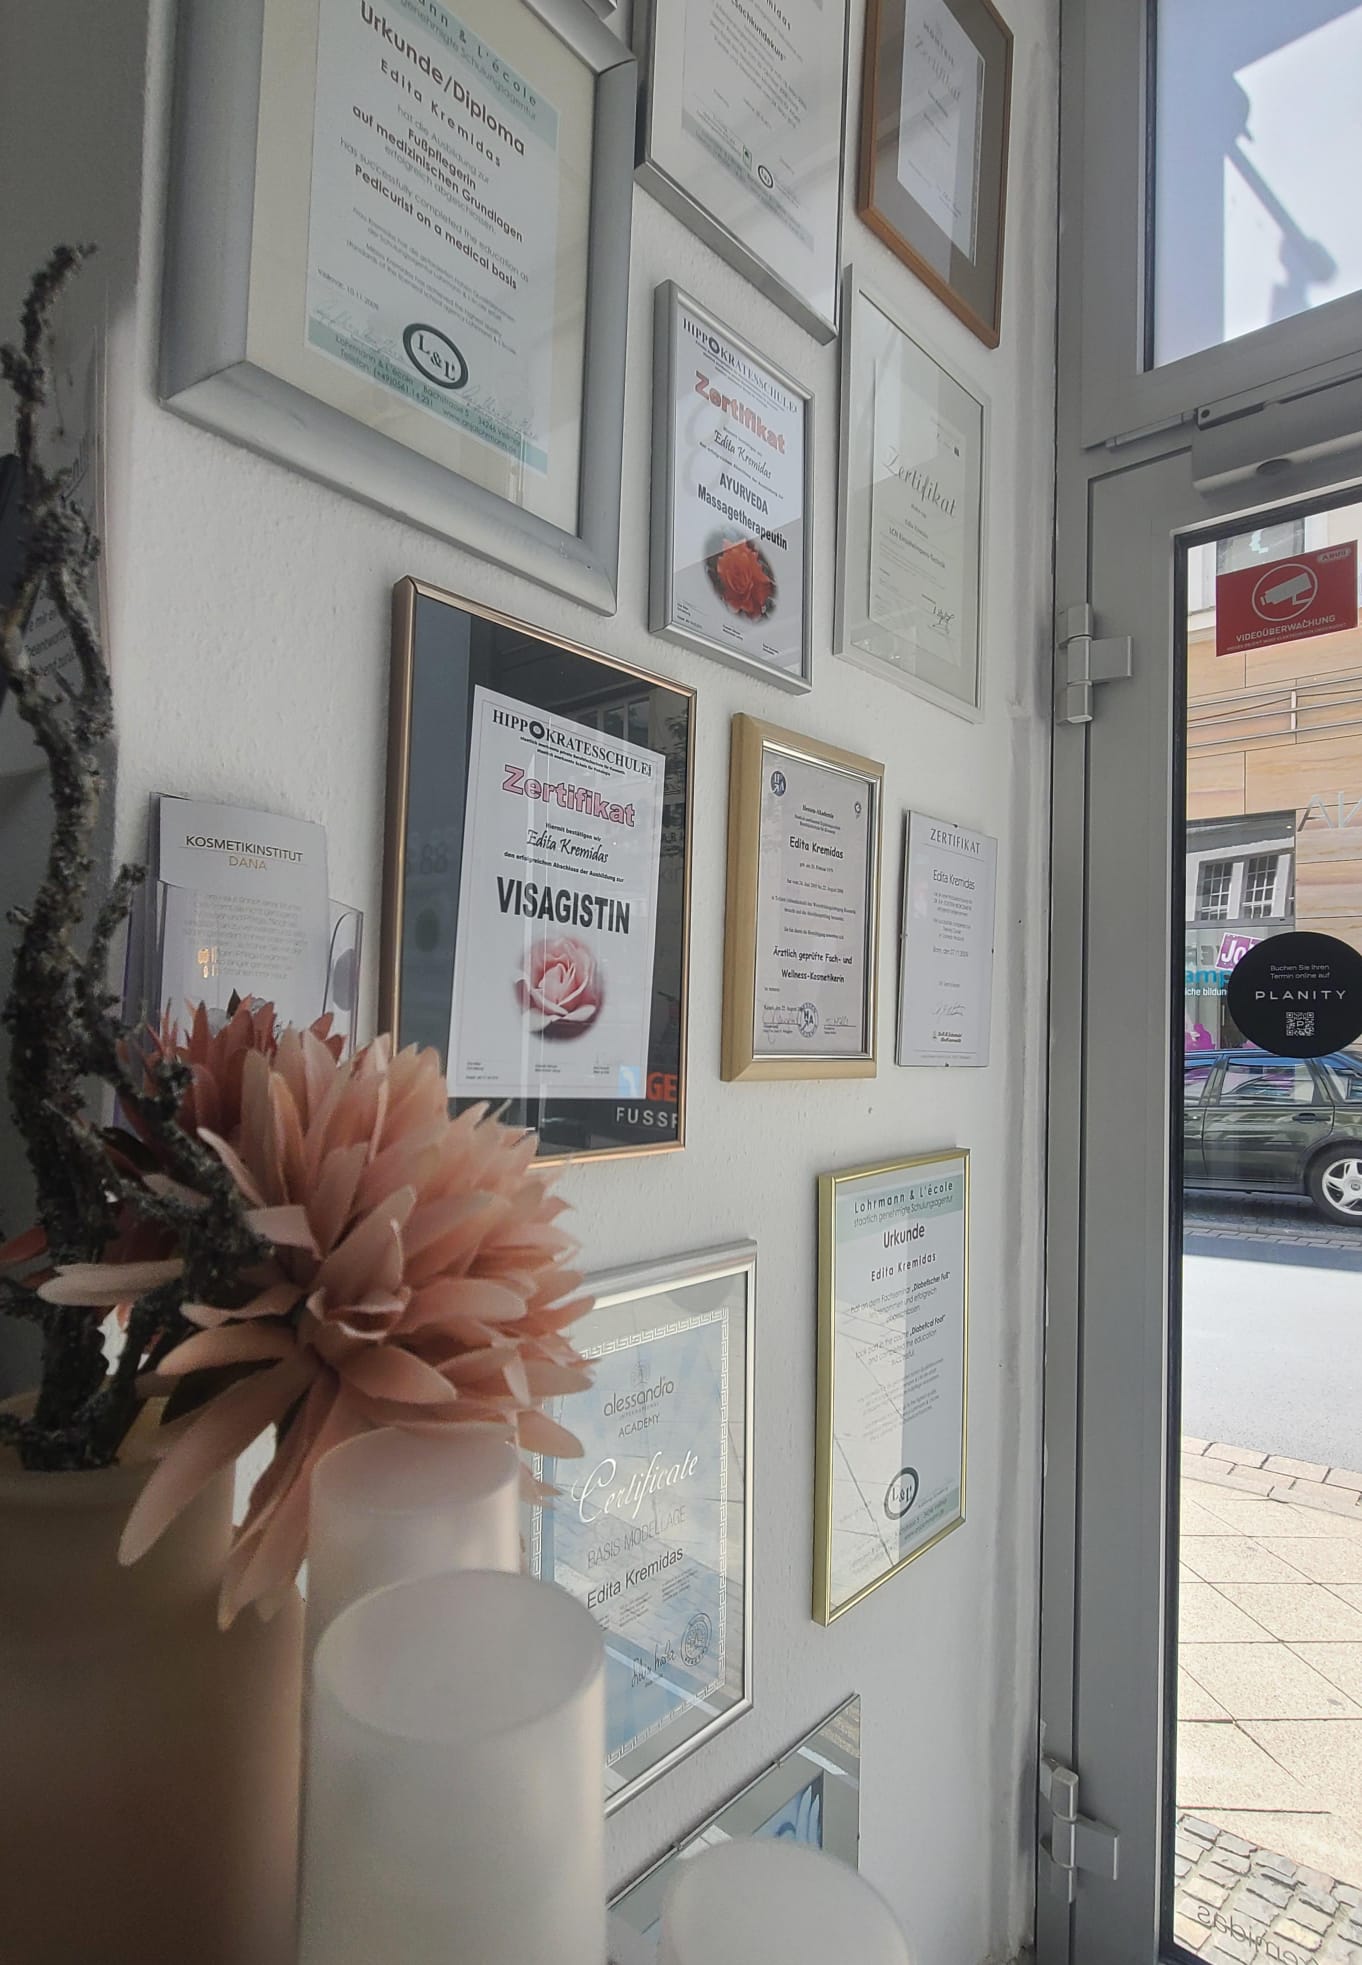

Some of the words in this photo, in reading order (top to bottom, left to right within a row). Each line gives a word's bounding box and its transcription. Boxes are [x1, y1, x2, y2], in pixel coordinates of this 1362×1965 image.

[360, 0, 526, 156] Urkunde/Diploma
[380, 58, 423, 103] Edita
[430, 100, 502, 168] Kremidas
[352, 104, 375, 128] auf
[376, 122, 460, 195] medizinischen
[461, 187, 524, 243] Grundlagen
[407, 127, 477, 190] Fußpflegerin
[354, 163, 415, 216] Pedicurist
[416, 210, 432, 229] on
[445, 230, 490, 271] medical
[491, 264, 518, 290] basis
[695, 369, 785, 455] Zertifikat
[714, 429, 736, 454] Edita
[737, 446, 772, 479] Kremidas
[719, 472, 769, 515] AYURVEDA
[698, 483, 788, 550] Massagetherapeutin
[1236, 615, 1336, 642] VIDEOÜBERWACHUNG
[502, 763, 636, 828] Zertifikat
[185, 835, 304, 863] KOSMETIKINSTITUT
[526, 828, 557, 851] Edita
[560, 838, 609, 864] Kremidas
[789, 836, 810, 852] Edita
[812, 842, 844, 859] Kremidas
[930, 828, 982, 855] ZERTIFIKAT
[228, 855, 268, 871] DANA
[496, 876, 631, 935] VISAGISTIN
[773, 945, 798, 959] Ärztlich
[798, 950, 824, 962] geprüfte
[781, 968, 845, 983] Wellness-Kosmetikerin
[1255, 990, 1346, 1000] PLANITY
[854, 1193, 905, 1214] Lohrmann
[910, 1189, 915, 1200] &
[883, 1223, 925, 1249] Urkunde
[871, 1265, 894, 1282] Edita
[898, 1252, 937, 1272] Kremidas
[603, 1376, 675, 1417] alessandro
[618, 1413, 661, 1439] ACADEMY
[571, 1450, 699, 1524] Certificate
[586, 1580, 622, 1610] Edita
[625, 1547, 684, 1590] Kremidas
